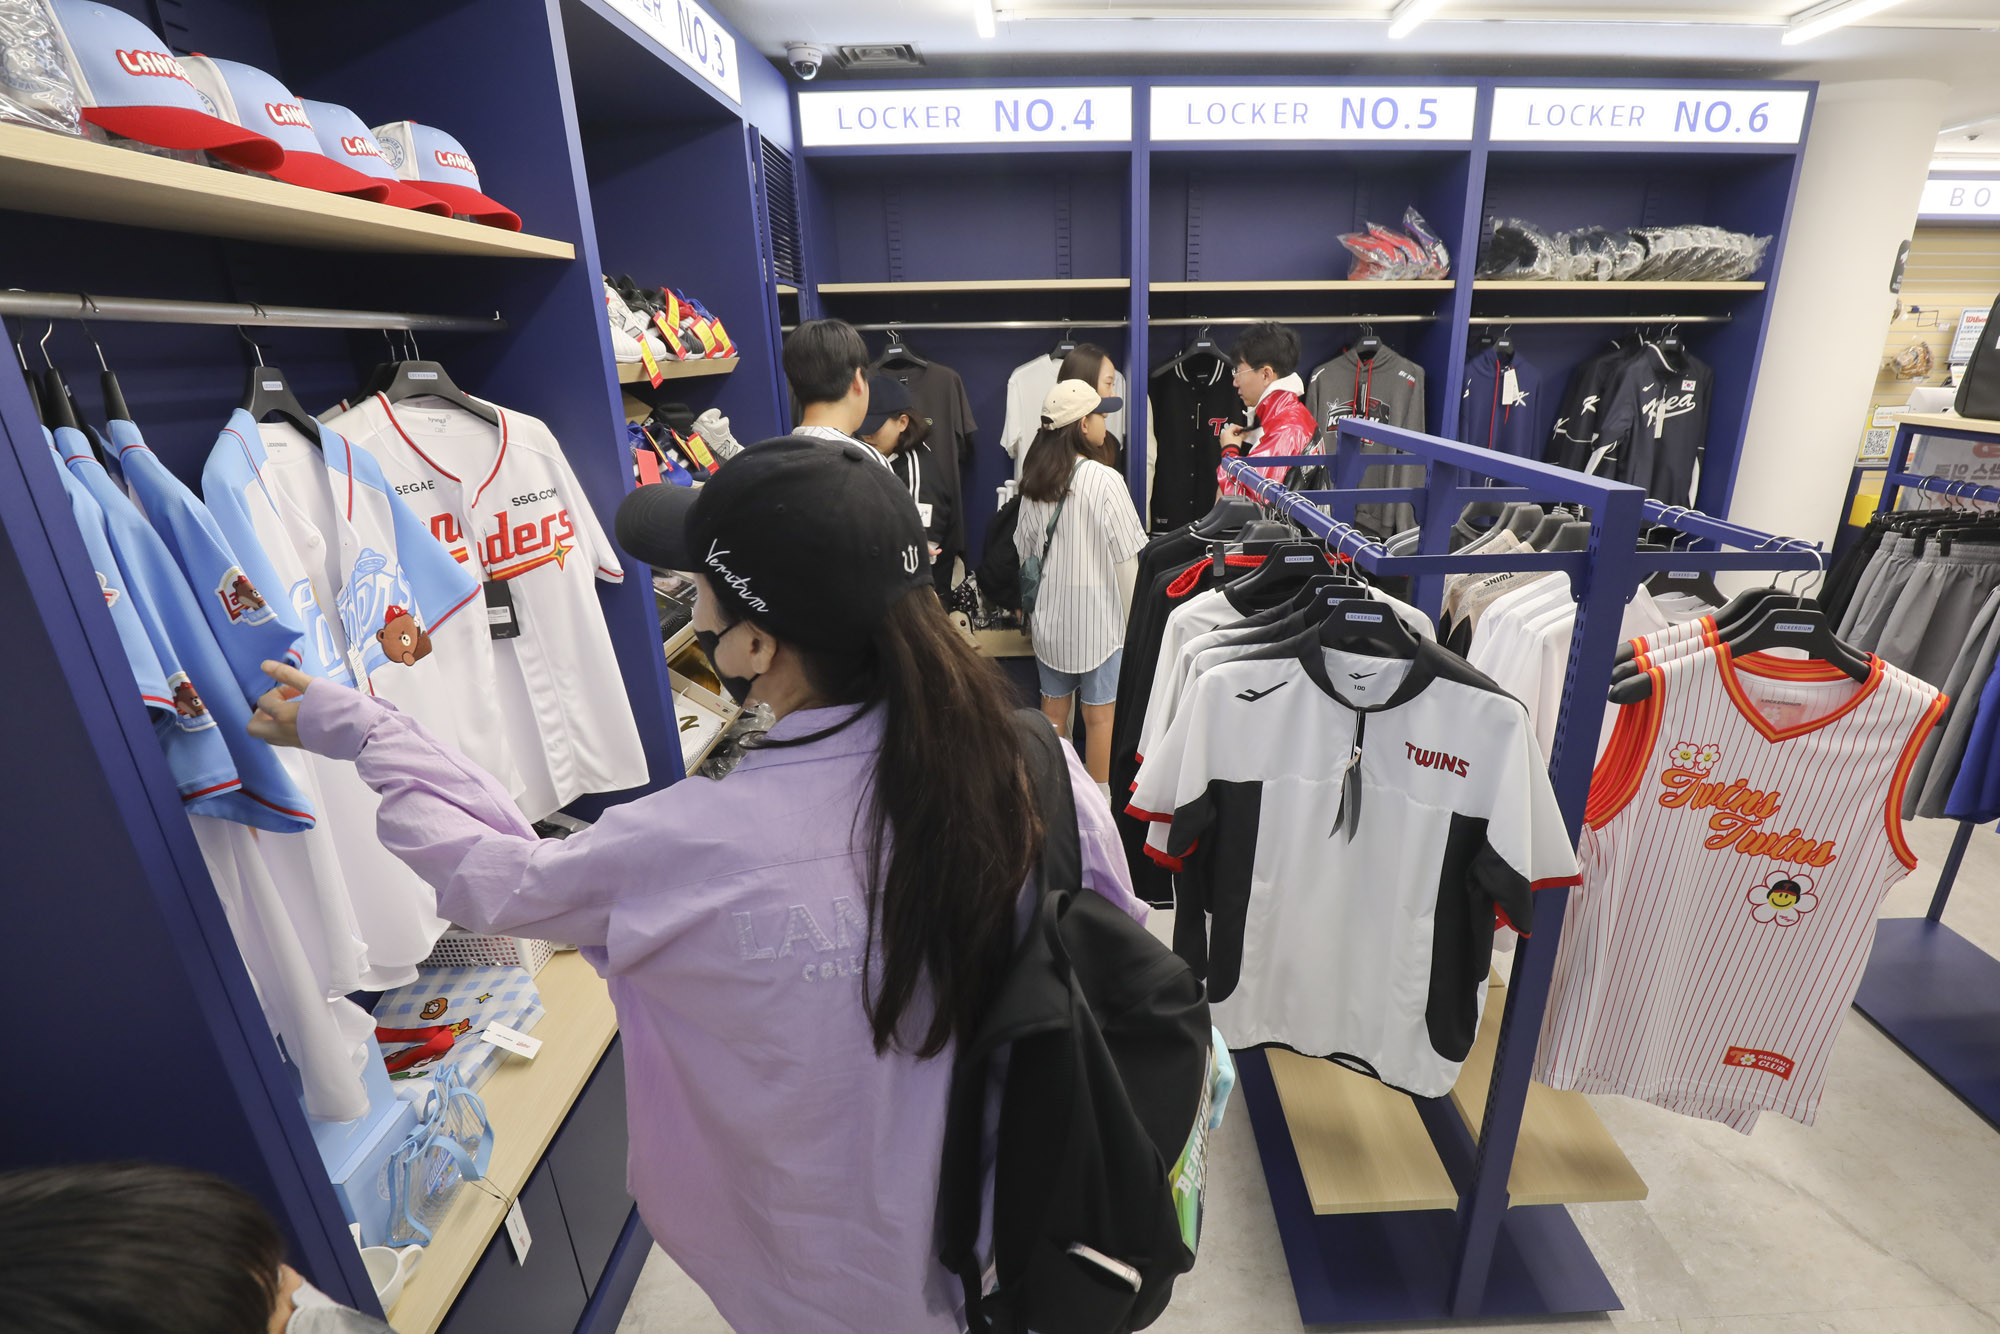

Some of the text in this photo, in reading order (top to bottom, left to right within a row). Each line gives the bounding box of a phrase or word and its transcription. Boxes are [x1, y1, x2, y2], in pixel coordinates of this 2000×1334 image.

[676, 0, 725, 78] NO.3
[837, 98, 1095, 132] LOCKER NO.4
[1187, 96, 1438, 130] LOCKER NO.5
[1527, 100, 1769, 133] LOCKER NO.6
[511, 487, 558, 507] SSG.COM
[1483, 572, 1514, 587] TWINS
[1346, 614, 1382, 622] LOCKERDIUM
[1775, 624, 1813, 632] LOCKERDIUM
[1353, 684, 1366, 692] 100
[1405, 741, 1470, 778] TWINS
[1659, 768, 1781, 819] Twins
[1704, 811, 1836, 867] Twins
[1757, 1054, 1791, 1068] BASEBALL
[1757, 1060, 1786, 1073] CLUB
